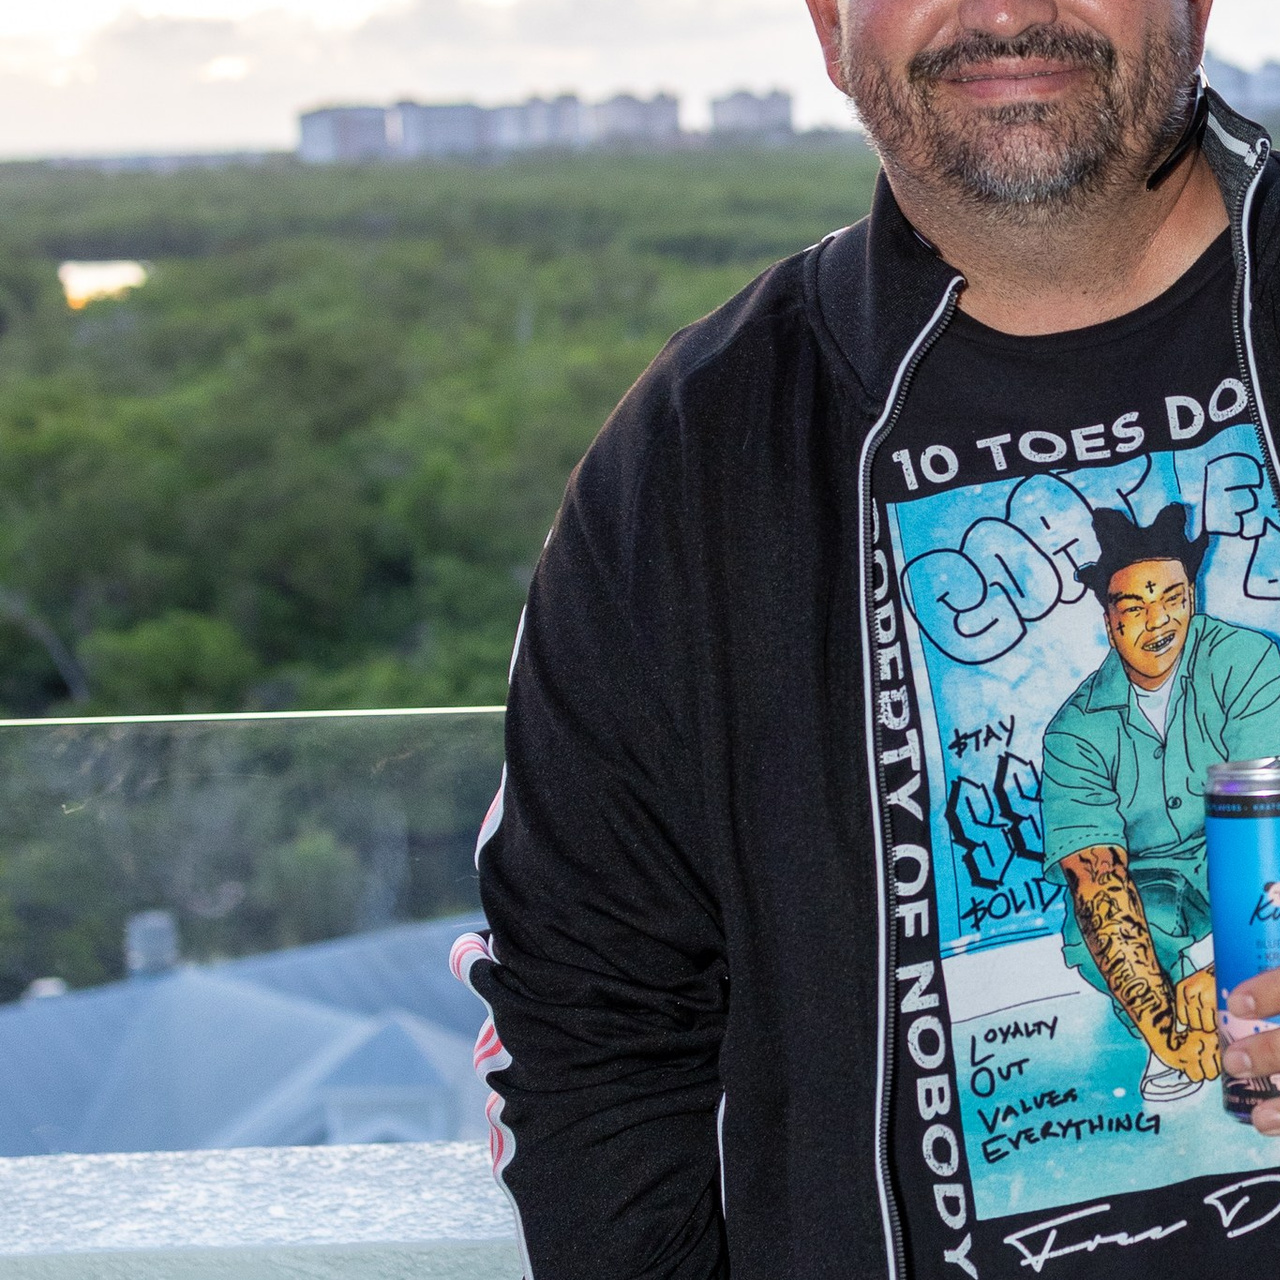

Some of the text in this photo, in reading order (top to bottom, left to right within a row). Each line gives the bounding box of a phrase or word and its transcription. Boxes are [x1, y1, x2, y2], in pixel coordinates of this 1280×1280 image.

[892, 377, 1249, 490] 10 TOES DO
[892, 843, 930, 937] OF
[970, 1016, 1058, 1067] LOYALTY
[970, 1058, 1031, 1098] OUT
[896, 960, 979, 1280] NOBODY
[977, 1087, 1078, 1134] VALUES
[981, 1111, 1161, 1164] EVERYTHING
